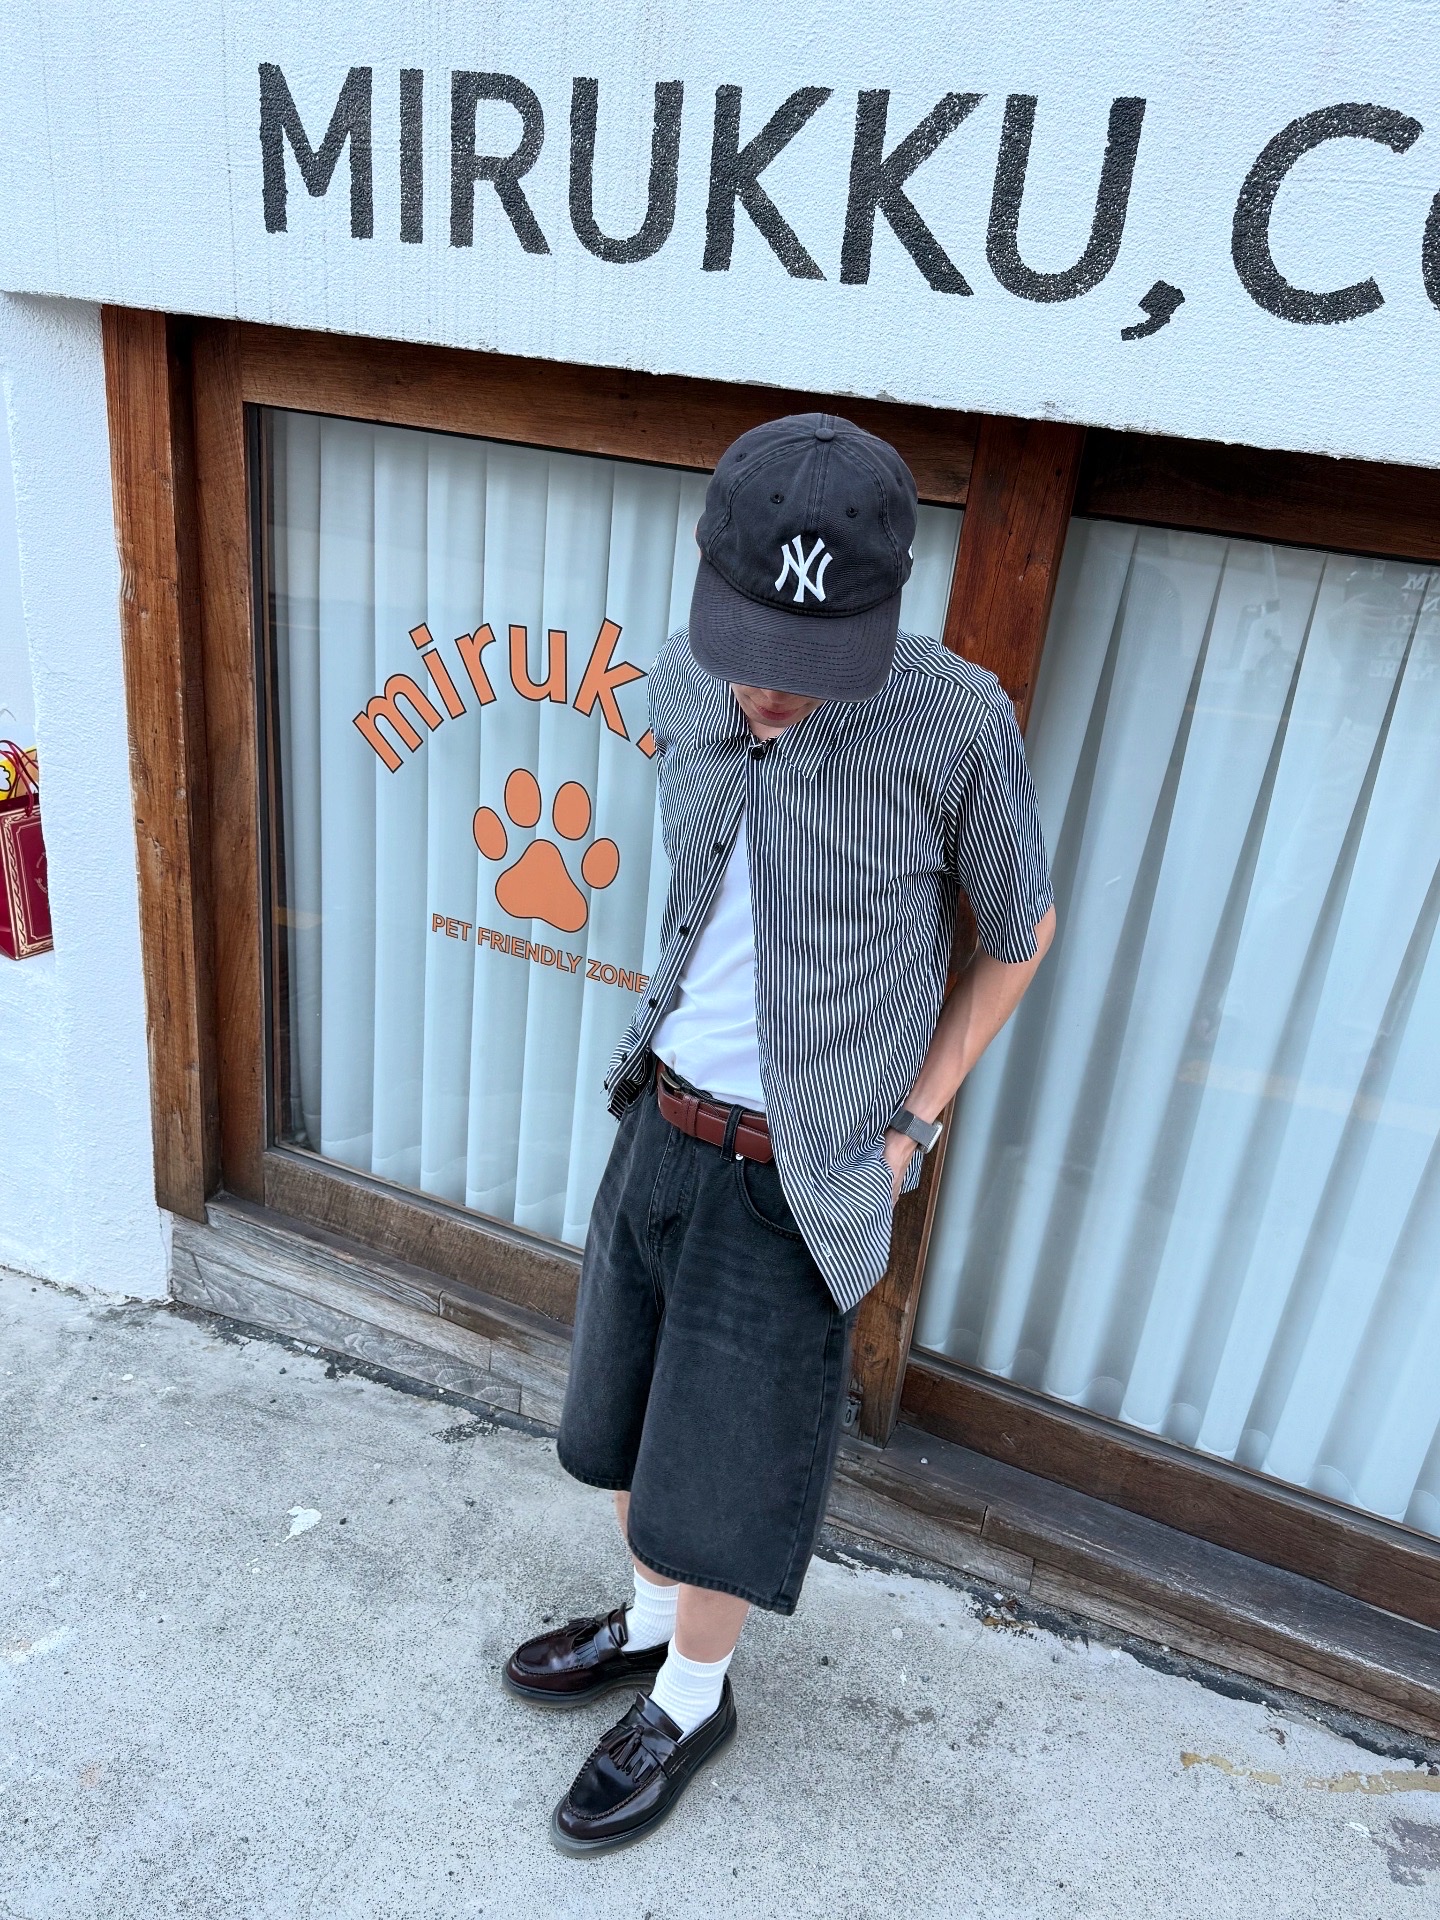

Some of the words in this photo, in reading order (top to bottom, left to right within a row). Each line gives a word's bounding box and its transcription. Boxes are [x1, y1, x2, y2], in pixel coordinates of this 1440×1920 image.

[1231, 102, 1440, 326] C
[774, 534, 833, 603] NY
[352, 618, 657, 774] miruk
[432, 913, 472, 941] PET
[477, 927, 582, 974] FRIENDLY
[586, 959, 650, 994] ZONE
